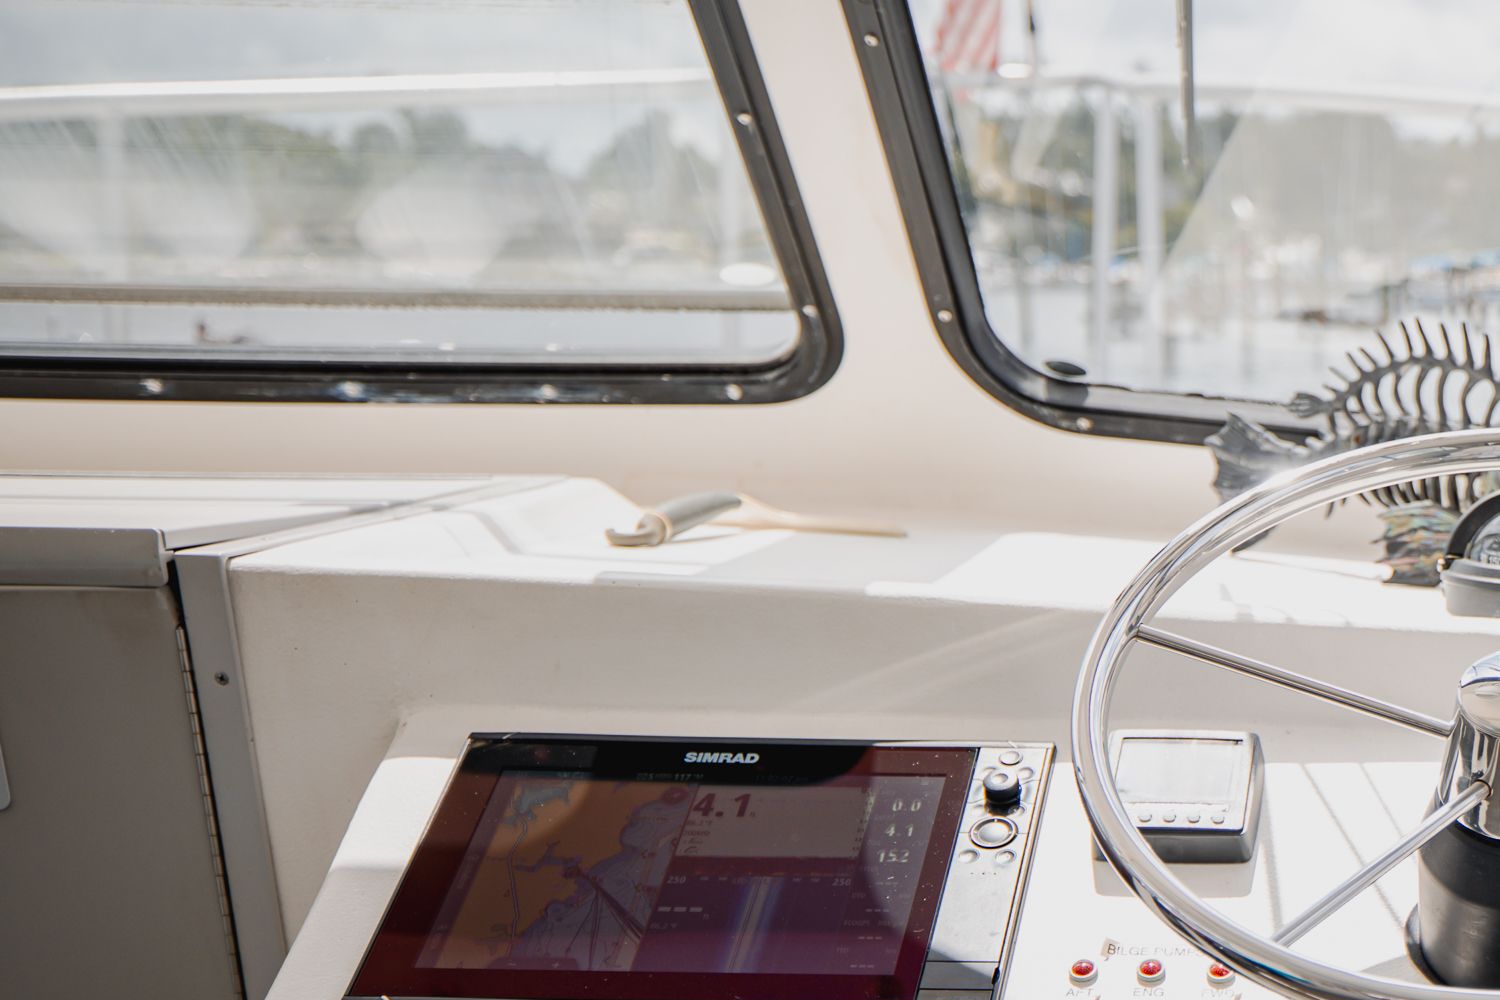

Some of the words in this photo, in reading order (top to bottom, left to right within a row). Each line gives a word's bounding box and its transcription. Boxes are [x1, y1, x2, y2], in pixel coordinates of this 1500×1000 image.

[684, 752, 760, 763] SIMRAD
[692, 793, 751, 817] 4.1
[1132, 988, 1165, 998] ENG
